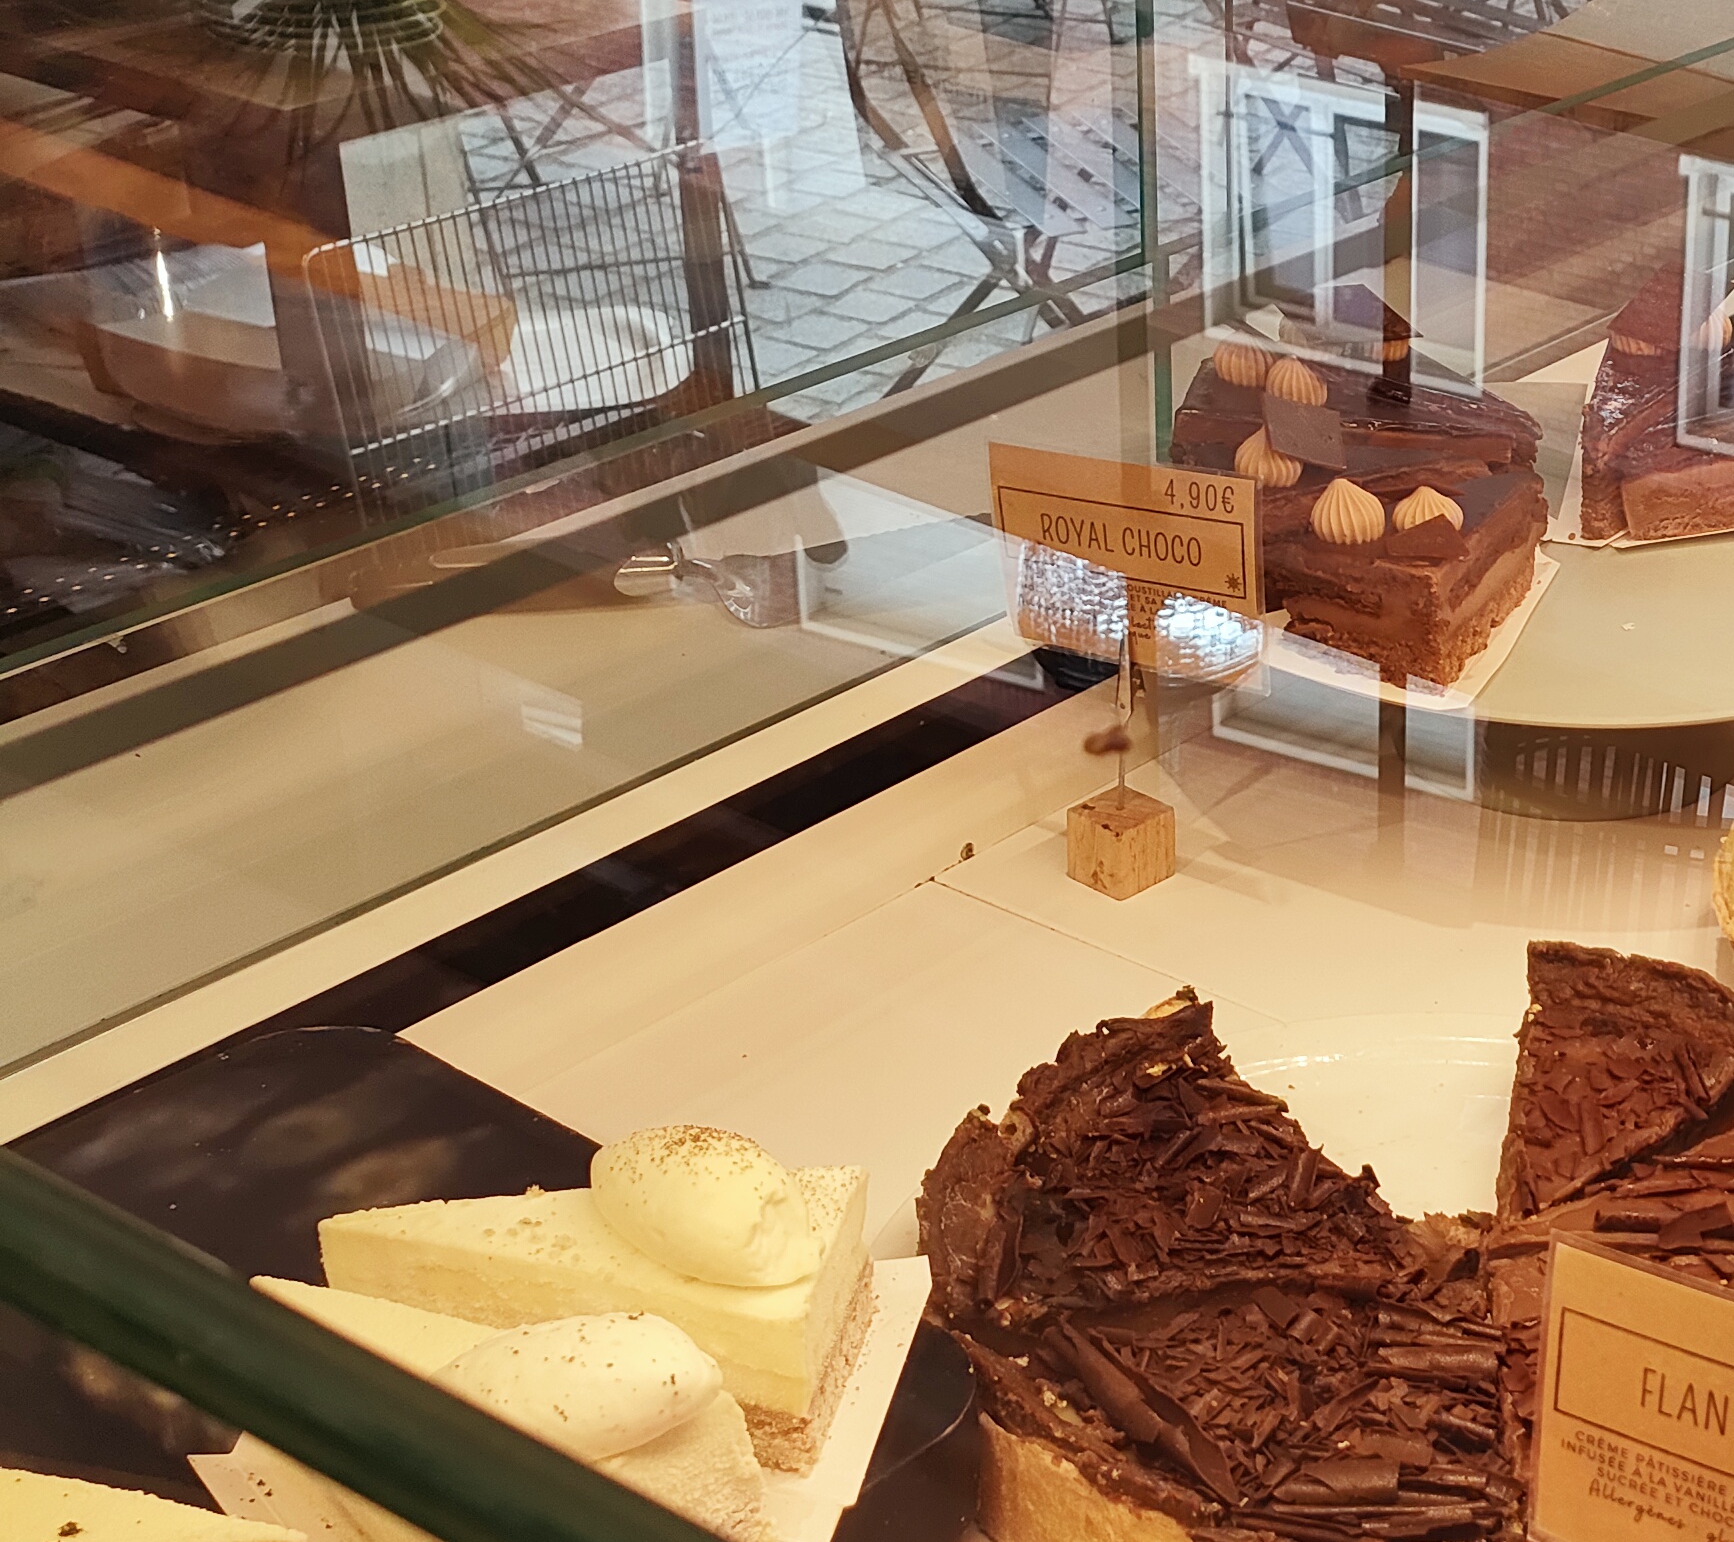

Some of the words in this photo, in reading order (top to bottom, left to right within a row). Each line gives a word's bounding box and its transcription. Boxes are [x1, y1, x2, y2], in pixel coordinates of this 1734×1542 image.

[1164, 478, 1235, 514] 4,90€
[1040, 513, 1115, 553] ROYAL
[1122, 527, 1202, 567] CHOCO
[1640, 1366, 1730, 1436] FLAN
[1561, 1438, 1626, 1472] INFUSÉE
[1649, 1473, 1667, 1488] LA
[1596, 1465, 1659, 1499] SUCRÉE
[1665, 1492, 1684, 1508] ET
[1588, 1478, 1687, 1530] Allergènes
